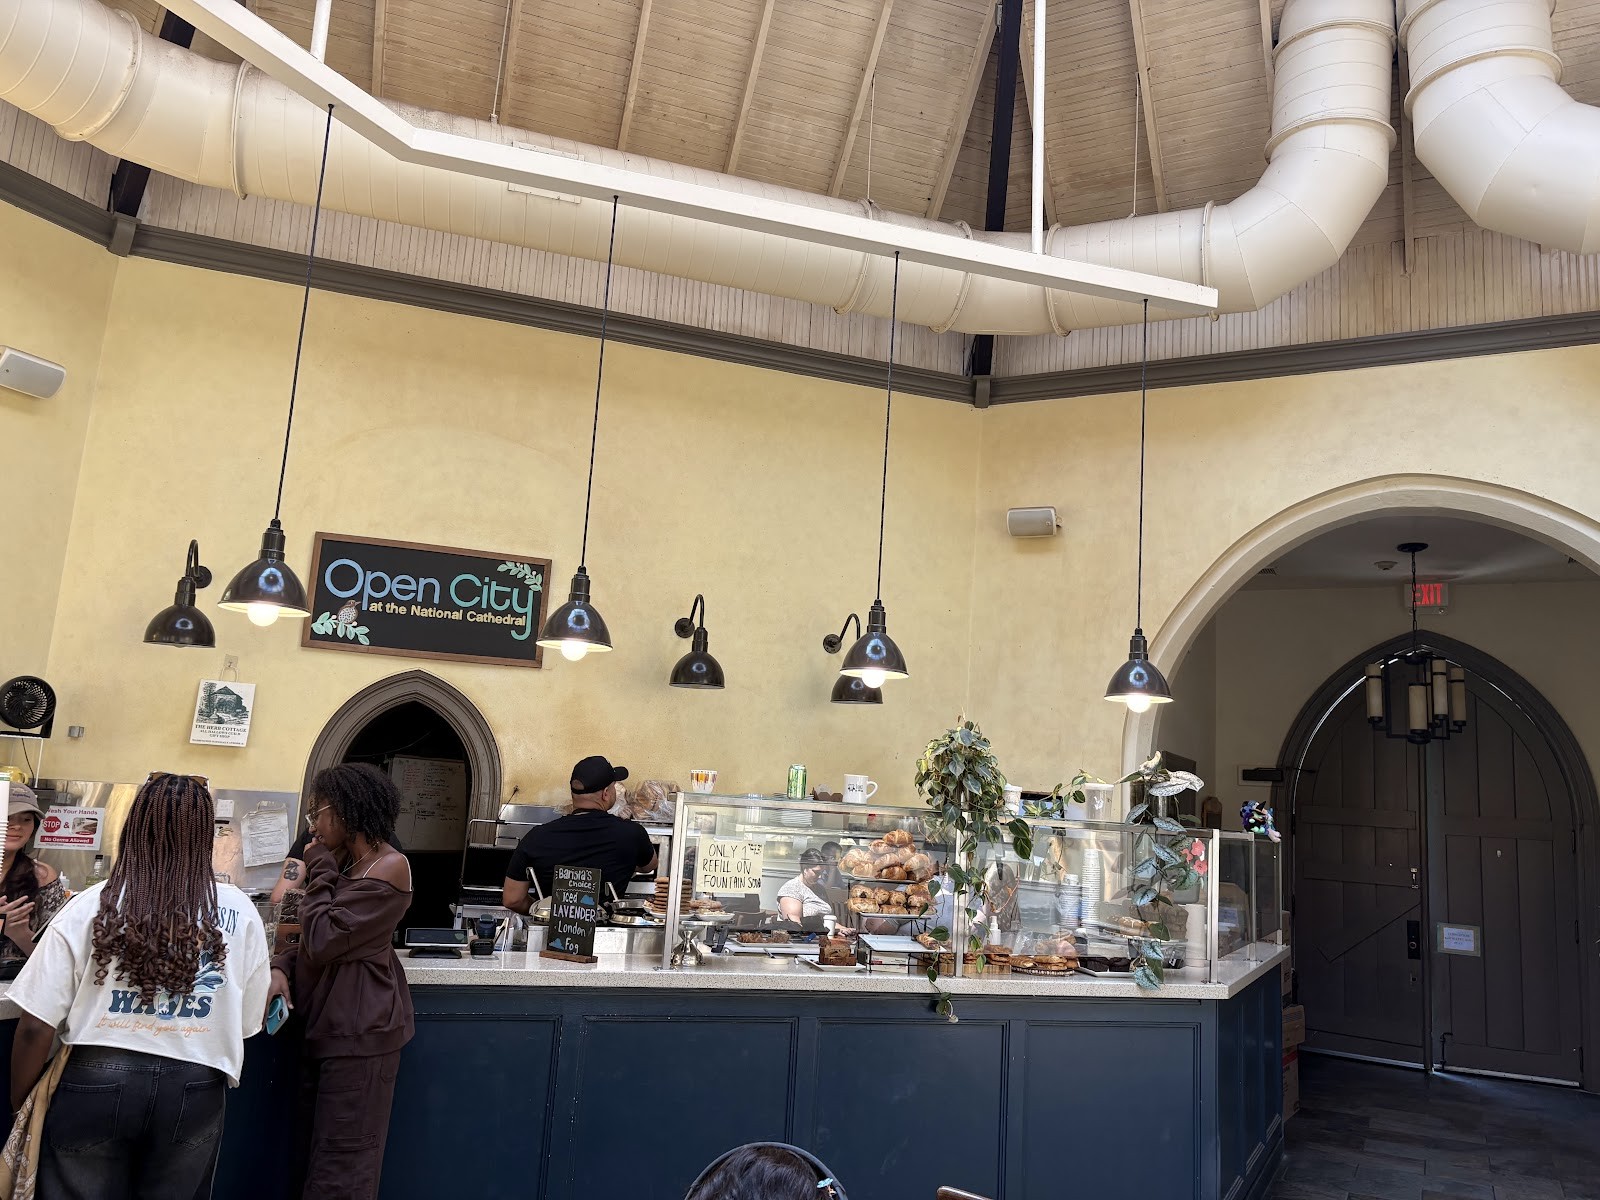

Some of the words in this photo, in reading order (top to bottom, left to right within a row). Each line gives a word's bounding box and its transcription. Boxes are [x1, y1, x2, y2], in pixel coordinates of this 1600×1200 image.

[325, 558, 441, 610] Open
[449, 573, 534, 641] City
[1412, 583, 1443, 607] EXIT
[369, 601, 383, 613] at
[385, 602, 407, 615] the
[411, 605, 463, 621] National
[466, 610, 527, 626] Cathedral
[43, 820, 61, 828] STOP
[708, 843, 738, 858] ONLY
[741, 845, 750, 860] 1
[702, 858, 732, 873] REFILL
[736, 860, 752, 874] ON
[703, 874, 746, 889] FOUNTAIN
[553, 904, 596, 922] LAVENDER
[558, 920, 586, 937] London
[564, 937, 579, 955] Fog
[153, 1024, 178, 1036] you
